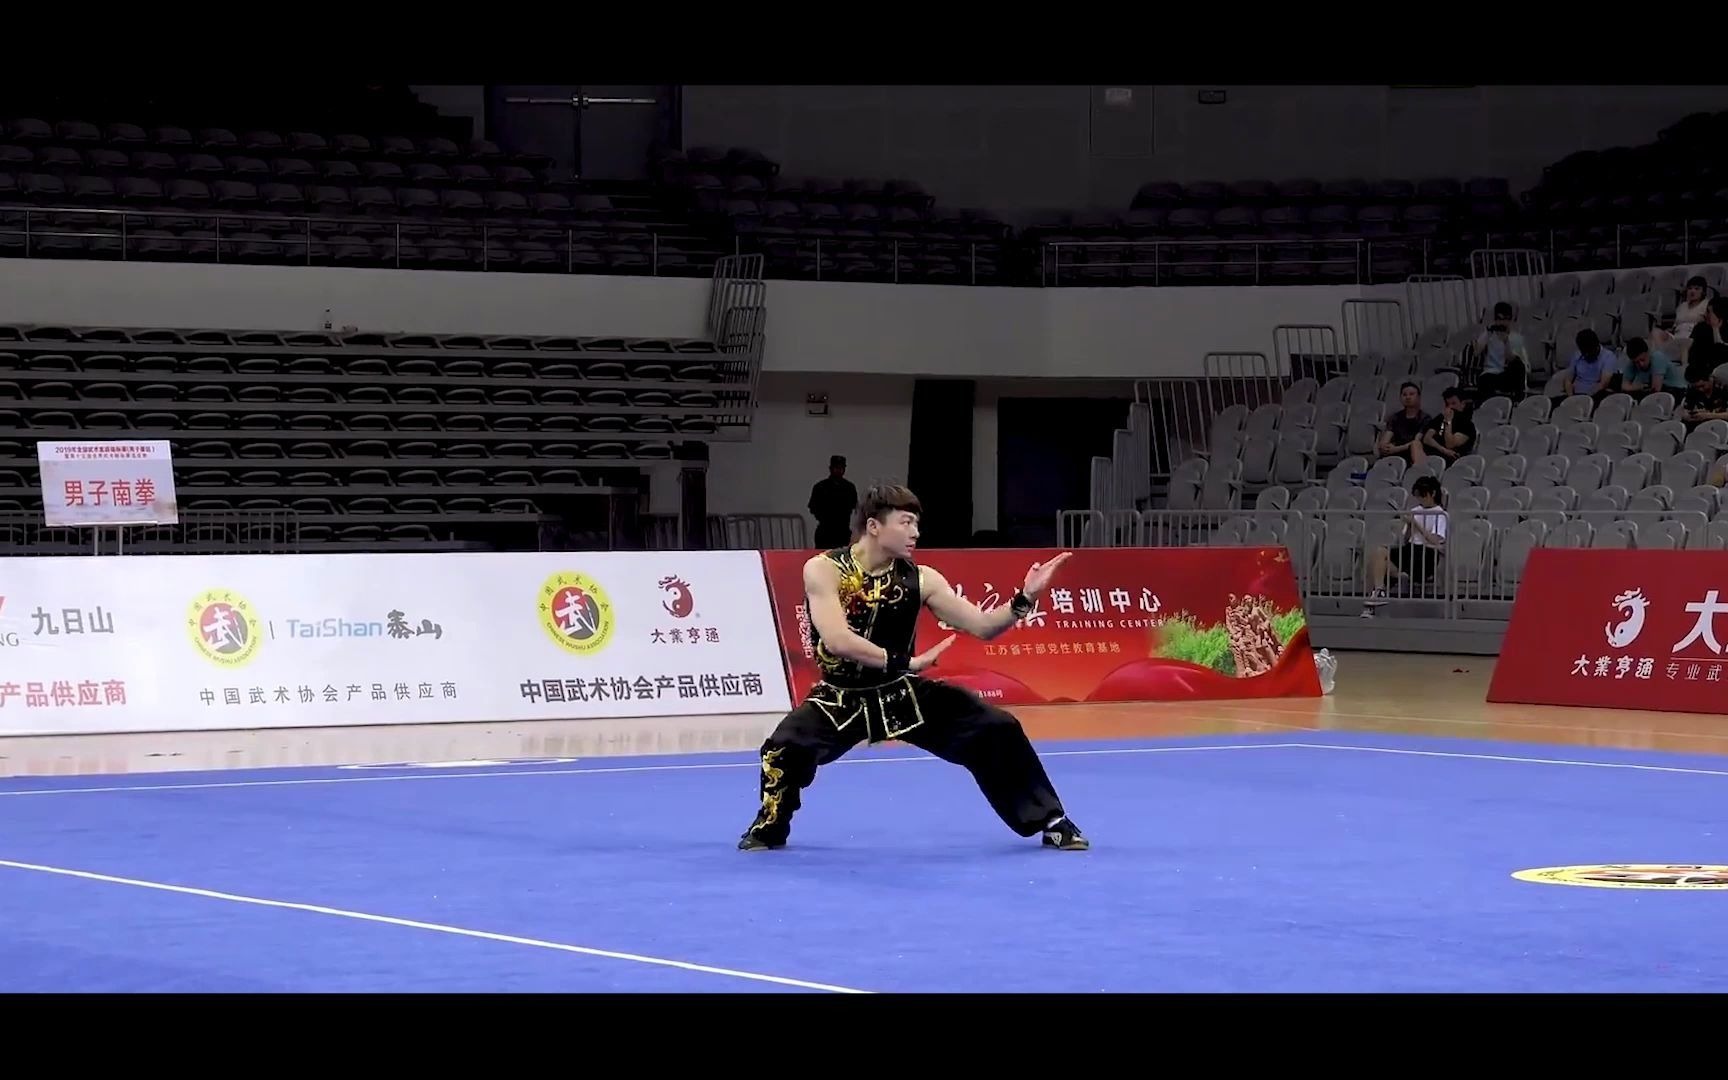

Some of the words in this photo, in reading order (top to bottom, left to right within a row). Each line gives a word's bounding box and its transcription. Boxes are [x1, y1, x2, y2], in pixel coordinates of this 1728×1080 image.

[64, 478, 156, 507] 男子南拳
[1050, 587, 1162, 613] 培训中心
[31, 606, 115, 635] 九日山
[286, 617, 383, 638] TaiShan
[387, 609, 443, 640] 泰山
[1056, 620, 1114, 628] TRAINING
[1120, 619, 1164, 628] CENTER
[1672, 590, 1728, 655] 大
[984, 641, 1121, 656] 江苏省干部党性教育基地
[1665, 662, 1723, 682] 专业武
[0, 678, 127, 708] 产品供应商
[199, 680, 457, 706] 中国武术协会产品供应商
[520, 672, 763, 704] 中国武术协会产品供应商
